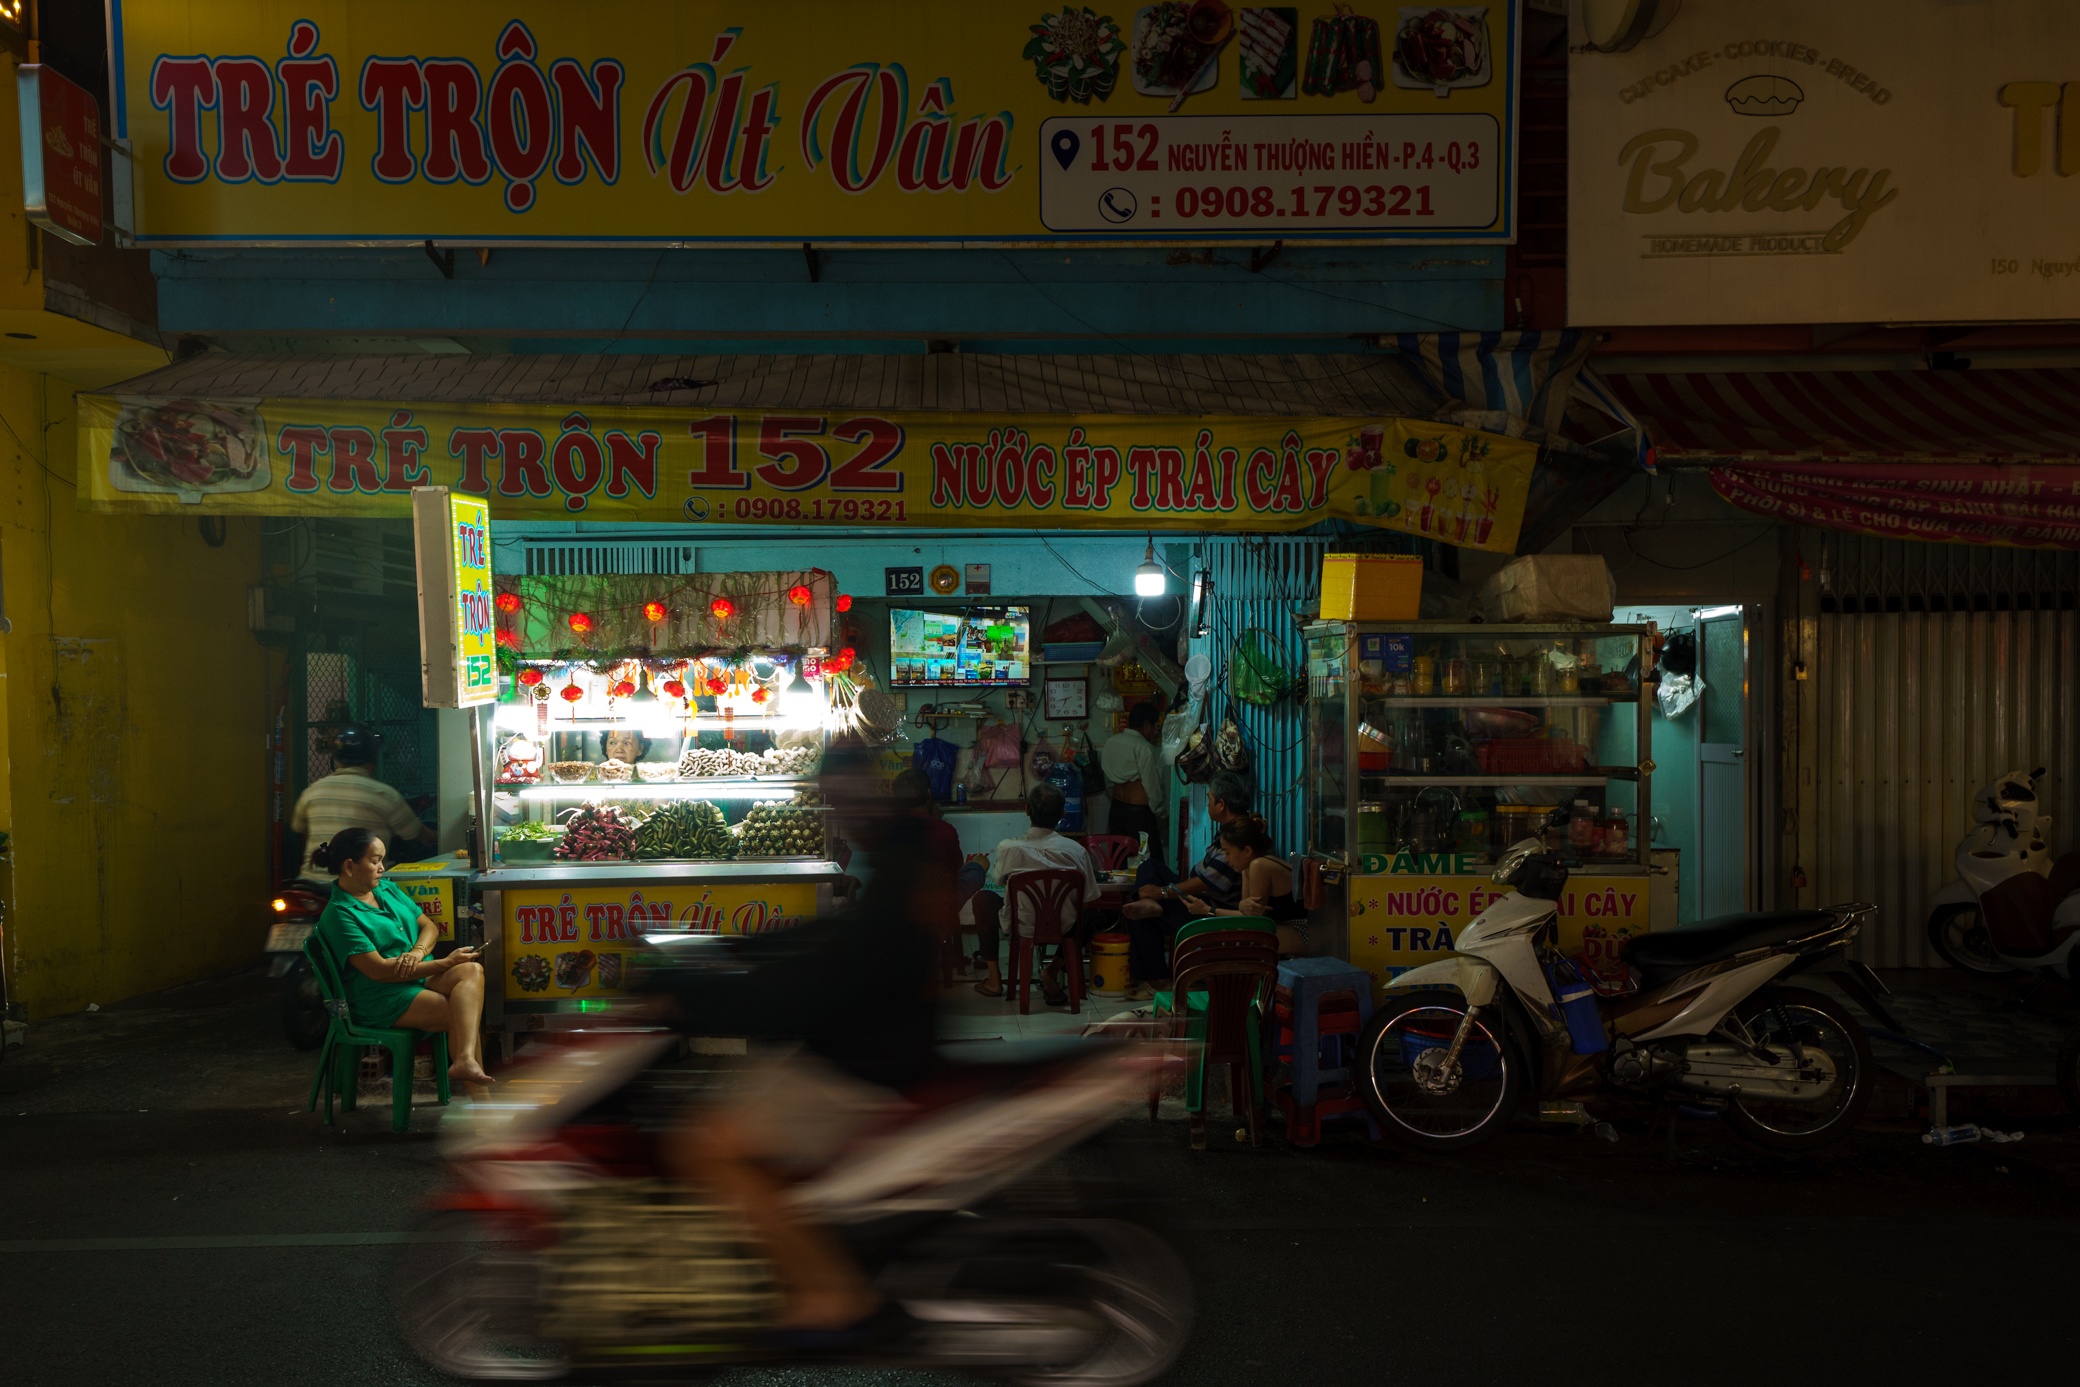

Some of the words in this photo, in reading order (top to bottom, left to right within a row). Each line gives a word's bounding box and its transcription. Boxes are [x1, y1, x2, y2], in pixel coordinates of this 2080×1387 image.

[1618, 50, 1713, 105] CUPCAKE
[1723, 39, 1821, 66] COOKIES
[1825, 57, 1893, 106] BREAD
[151, 19, 344, 184] TRÉ
[359, 19, 625, 214] TRỘN
[641, 28, 784, 195] Út
[801, 62, 1020, 195] Vân
[1998, 81, 2080, 178] T
[1091, 124, 1160, 172] 152
[1168, 130, 1248, 172] NGUYỄN
[1254, 137, 1335, 176] THƯỢNG
[1176, 185, 1435, 218] 0908.179321
[1617, 124, 1899, 253] Bakery
[1651, 236, 1744, 253] HOMEMADE
[1750, 235, 1825, 252] PRODUCT
[1991, 258, 2019, 275] 150
[278, 409, 431, 496] TRÉ
[449, 411, 662, 513] TRỘN
[690, 415, 906, 493] 152
[932, 427, 1057, 510] NƯỚC
[1062, 427, 1122, 510] ÉP
[1128, 429, 1240, 513] TRÁI
[1244, 430, 1340, 514] CÂY
[1913, 479, 1974, 494] SINH
[735, 497, 908, 522] 0908.179321
[1812, 506, 1826, 520] &
[1859, 510, 1902, 529] CHO
[2022, 524, 2080, 541] BÁNH
[1938, 499, 1998, 516] BÁNH
[459, 510, 486, 568] TRÉ
[889, 573, 921, 590] 152
[461, 580, 490, 646] TRỘN
[1388, 643, 1405, 651] 10k
[466, 655, 491, 687] 152
[405, 885, 440, 896] Vân
[1387, 888, 1459, 917] NƯỚC
[1584, 887, 1637, 916] CÂY
[516, 893, 579, 945] TRÉ
[1386, 921, 1455, 951] TRÀ
